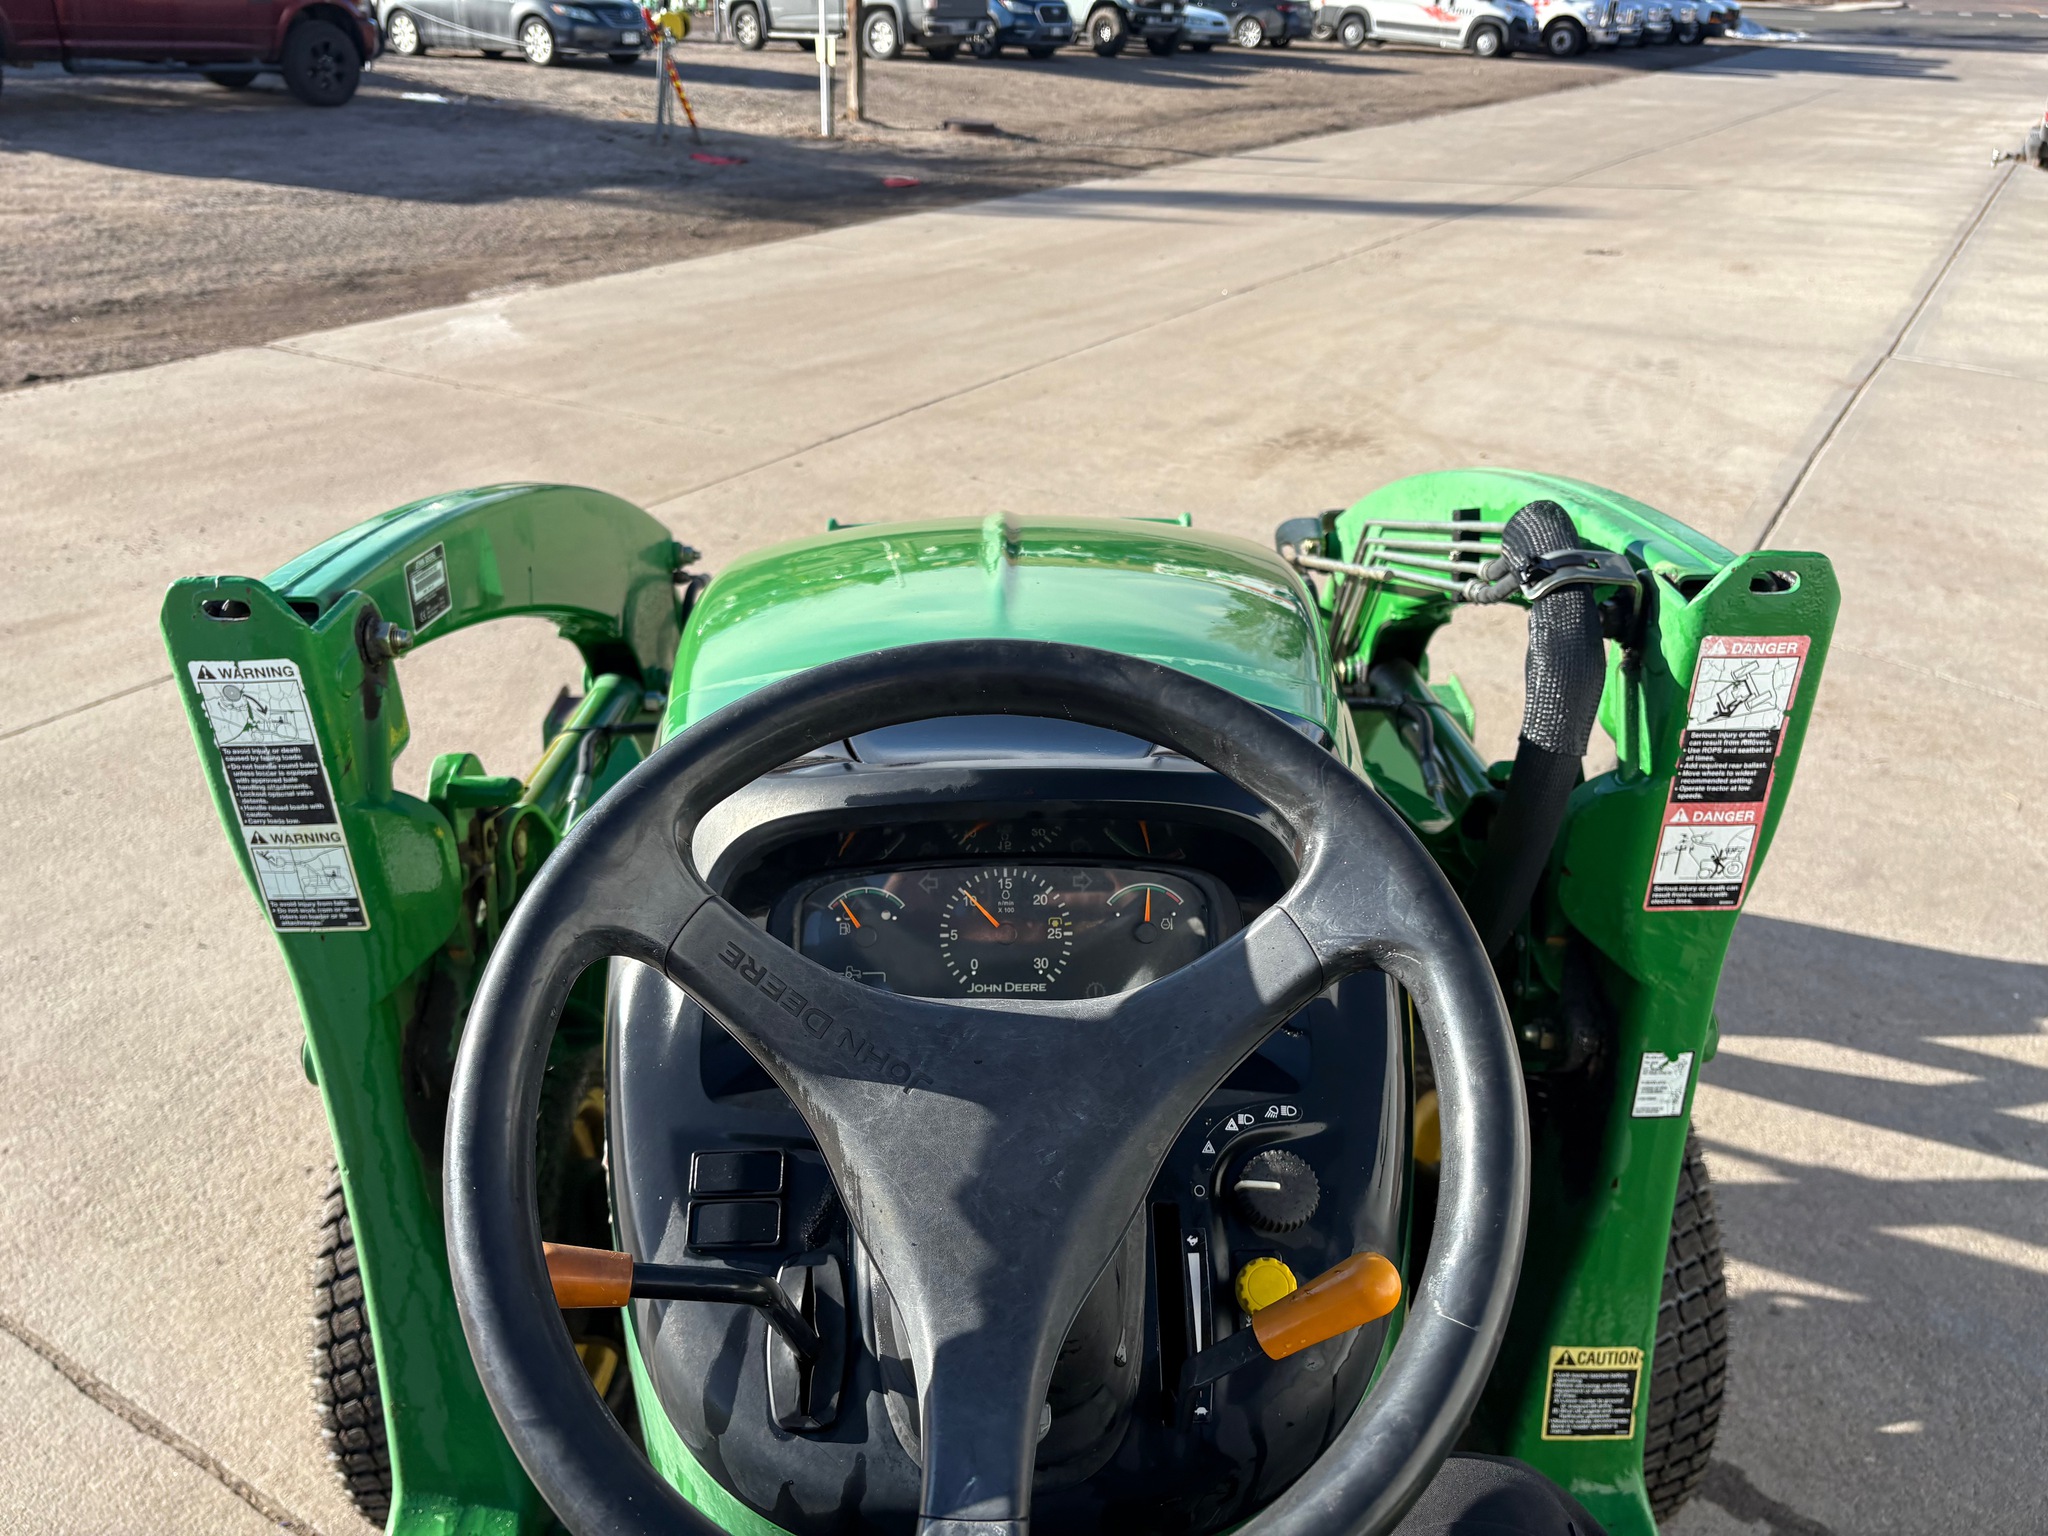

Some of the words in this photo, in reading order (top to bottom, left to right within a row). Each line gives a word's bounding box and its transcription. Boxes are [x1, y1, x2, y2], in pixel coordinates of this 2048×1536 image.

[1731, 642, 1798, 654] DANGER
[218, 666, 295, 679] WARNING
[1699, 762, 1727, 770] required
[1693, 810, 1755, 822] DANGER
[270, 832, 341, 844] WARNING
[998, 878, 1012, 889] 15
[964, 896, 977, 906] 10
[1033, 895, 1048, 905] 20
[950, 930, 958, 940] 5
[1047, 928, 1062, 939] 25
[970, 959, 978, 970] 0
[1033, 958, 1049, 969] 30
[718, 940, 834, 1039] DEERE
[967, 983, 1002, 993] JOHN
[1005, 982, 1046, 992] DEERE
[838, 1027, 934, 1094] JOHN
[1577, 1351, 1639, 1365] CAUTION
